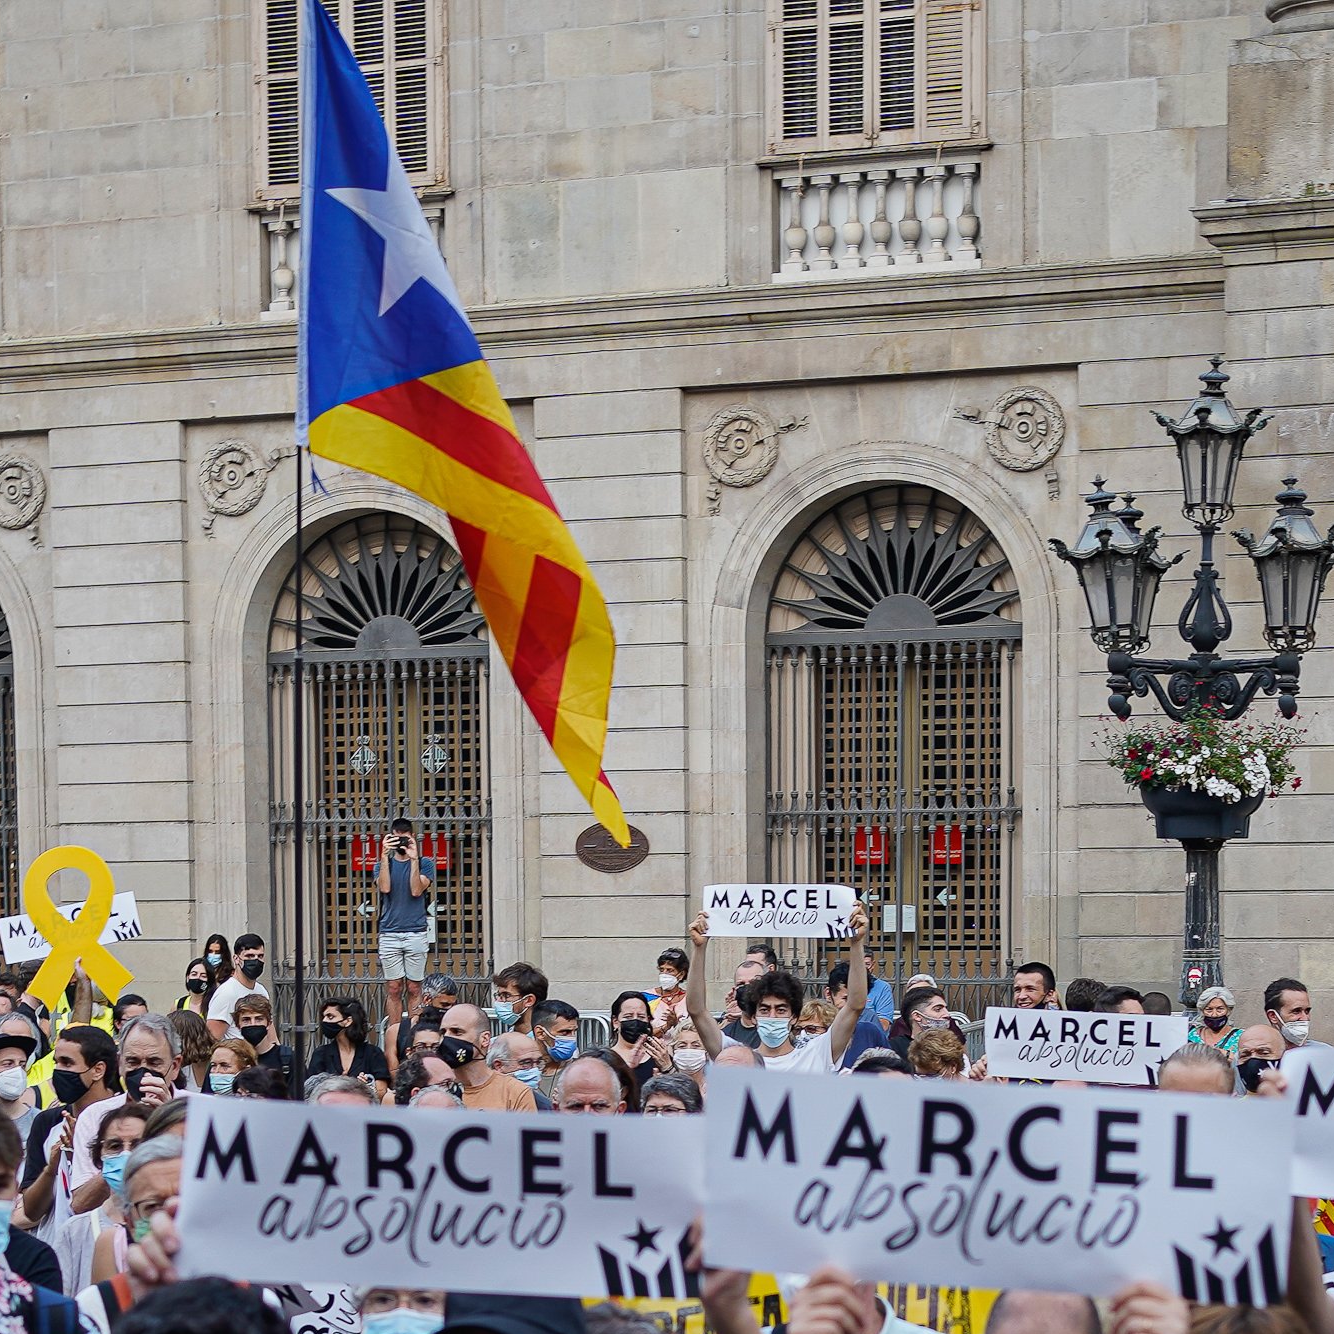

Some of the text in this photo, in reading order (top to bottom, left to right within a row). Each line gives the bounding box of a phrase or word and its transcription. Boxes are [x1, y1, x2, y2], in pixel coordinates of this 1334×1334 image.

[710, 888, 838, 909] MARCEL
[729, 901, 821, 930] absolució
[993, 1014, 1162, 1048] MARCEL
[1017, 1033, 1138, 1073] absolució
[194, 1116, 635, 1200] MARCEL
[732, 1086, 1215, 1191] MARCEL
[258, 1165, 574, 1268] absolució
[793, 1150, 1148, 1265] absolució
